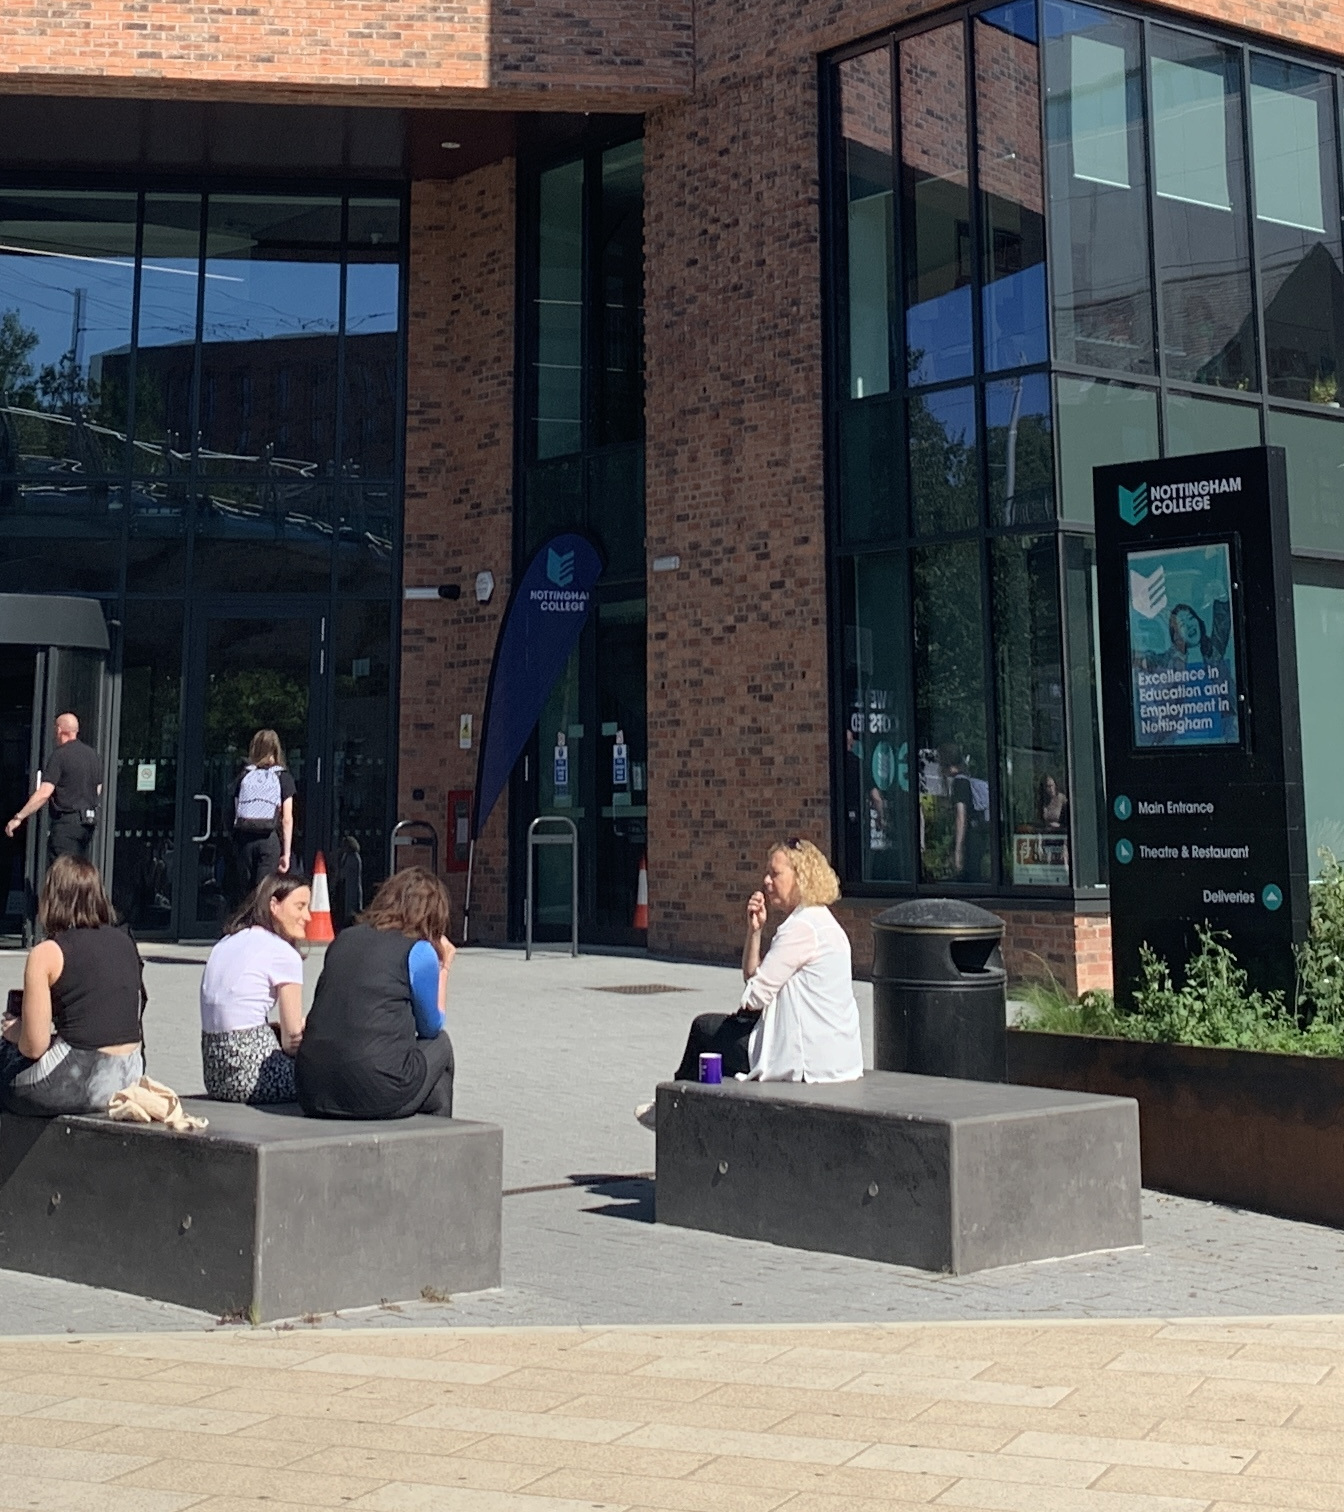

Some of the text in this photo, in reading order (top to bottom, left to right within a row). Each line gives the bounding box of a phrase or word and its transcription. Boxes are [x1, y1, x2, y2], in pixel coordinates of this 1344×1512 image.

[1150, 476, 1242, 501] NOTTINGHAM
[1151, 495, 1211, 516] COLLEGE
[540, 600, 585, 612] COLLEGE
[1138, 664, 1220, 686] Excellence in
[1139, 679, 1229, 702] Education and
[1140, 697, 1230, 719] Employment in
[1141, 717, 1213, 735] Nottingham
[1138, 801, 1215, 815] Main Entrance
[1139, 845, 1250, 859] Theatre & Restaurant
[1202, 889, 1255, 904] Deliveries
